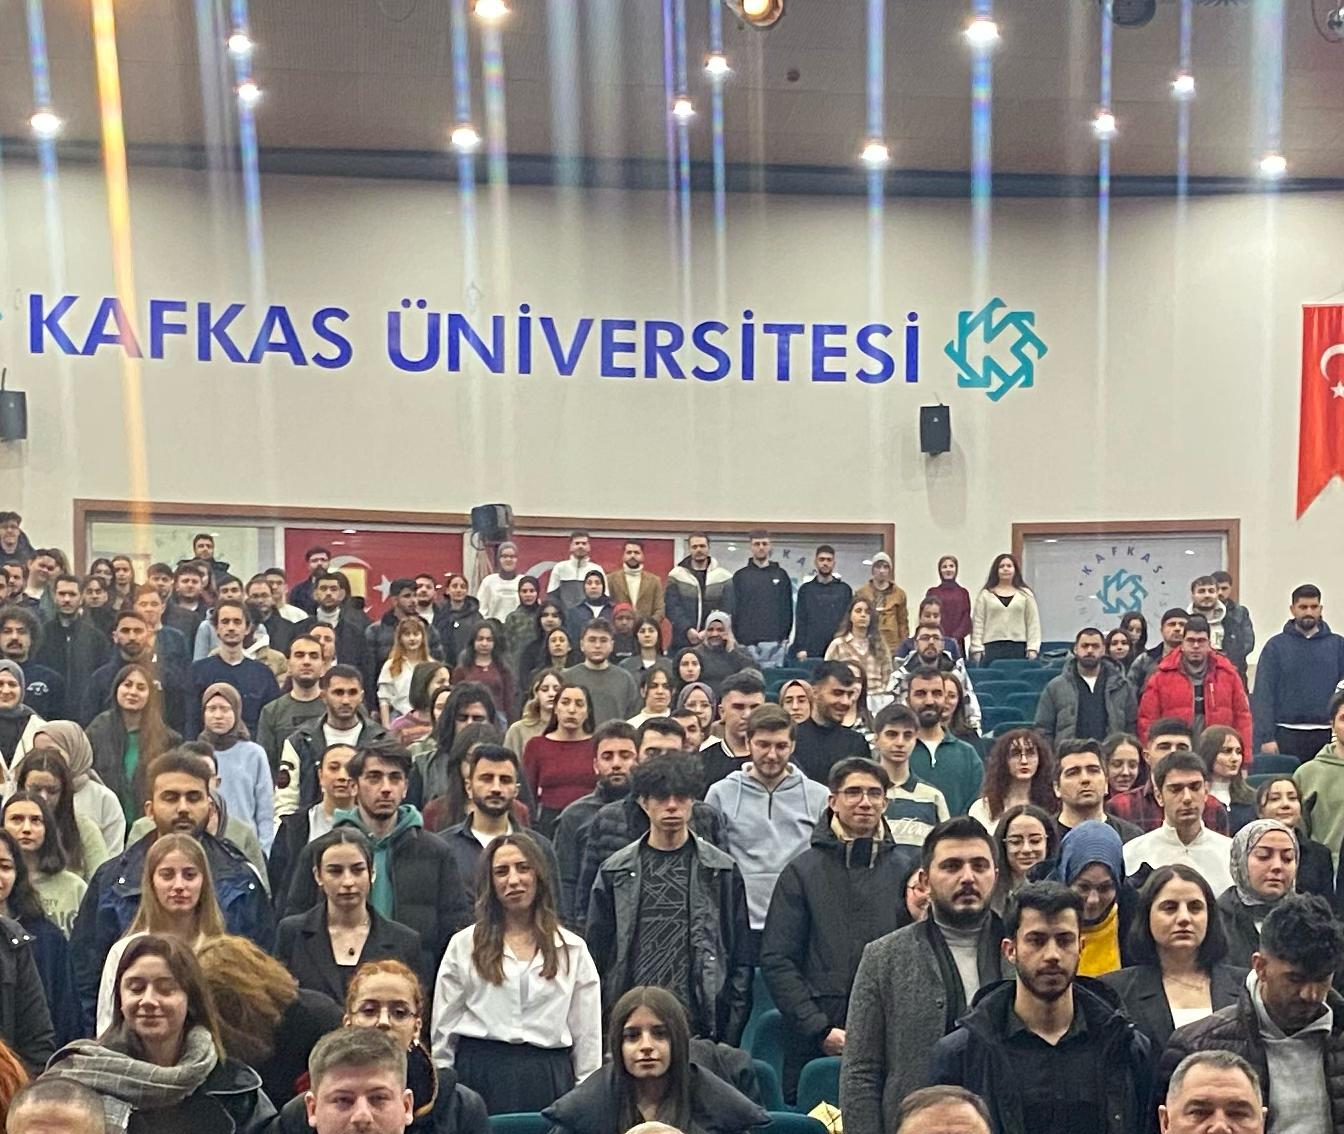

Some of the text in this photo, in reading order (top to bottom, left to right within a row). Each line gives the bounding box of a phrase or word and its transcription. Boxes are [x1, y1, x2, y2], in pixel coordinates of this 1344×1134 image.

[29, 294, 920, 383] KAFKAS ÜNİVERSİTESİ
[1081, 546, 1163, 576] KAFKAS
